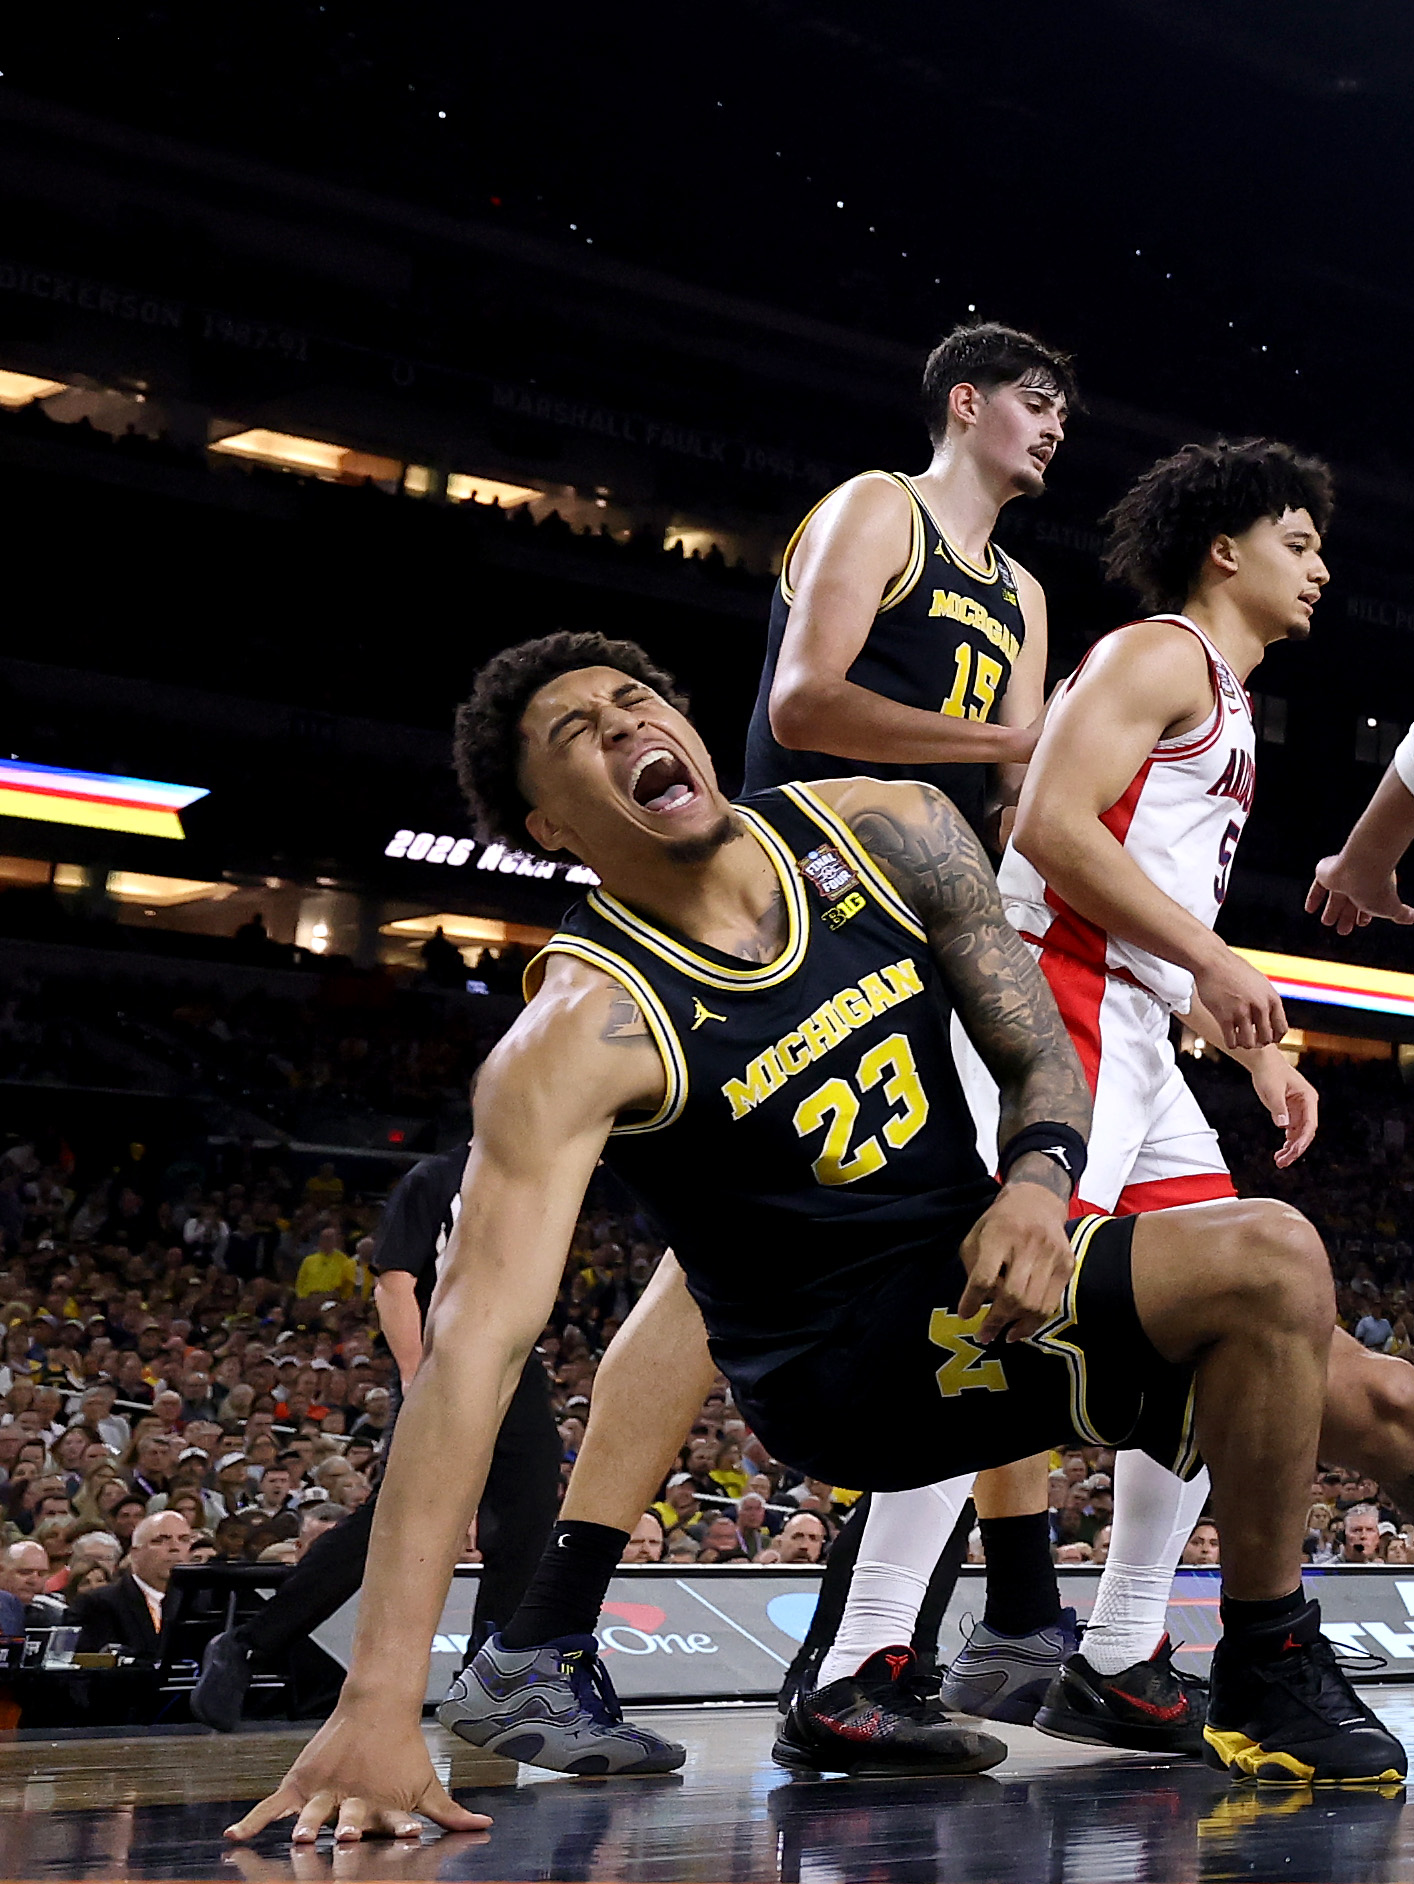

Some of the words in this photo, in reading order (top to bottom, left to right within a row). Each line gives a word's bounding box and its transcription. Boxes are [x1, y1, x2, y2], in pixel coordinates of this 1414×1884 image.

[940, 641, 1003, 723] 15
[384, 829, 476, 866] 2026
[804, 852, 838, 876] FINAL
[821, 869, 853, 893] FOUR
[721, 958, 925, 1121] MICHIGAN
[792, 1032, 930, 1186] 23
